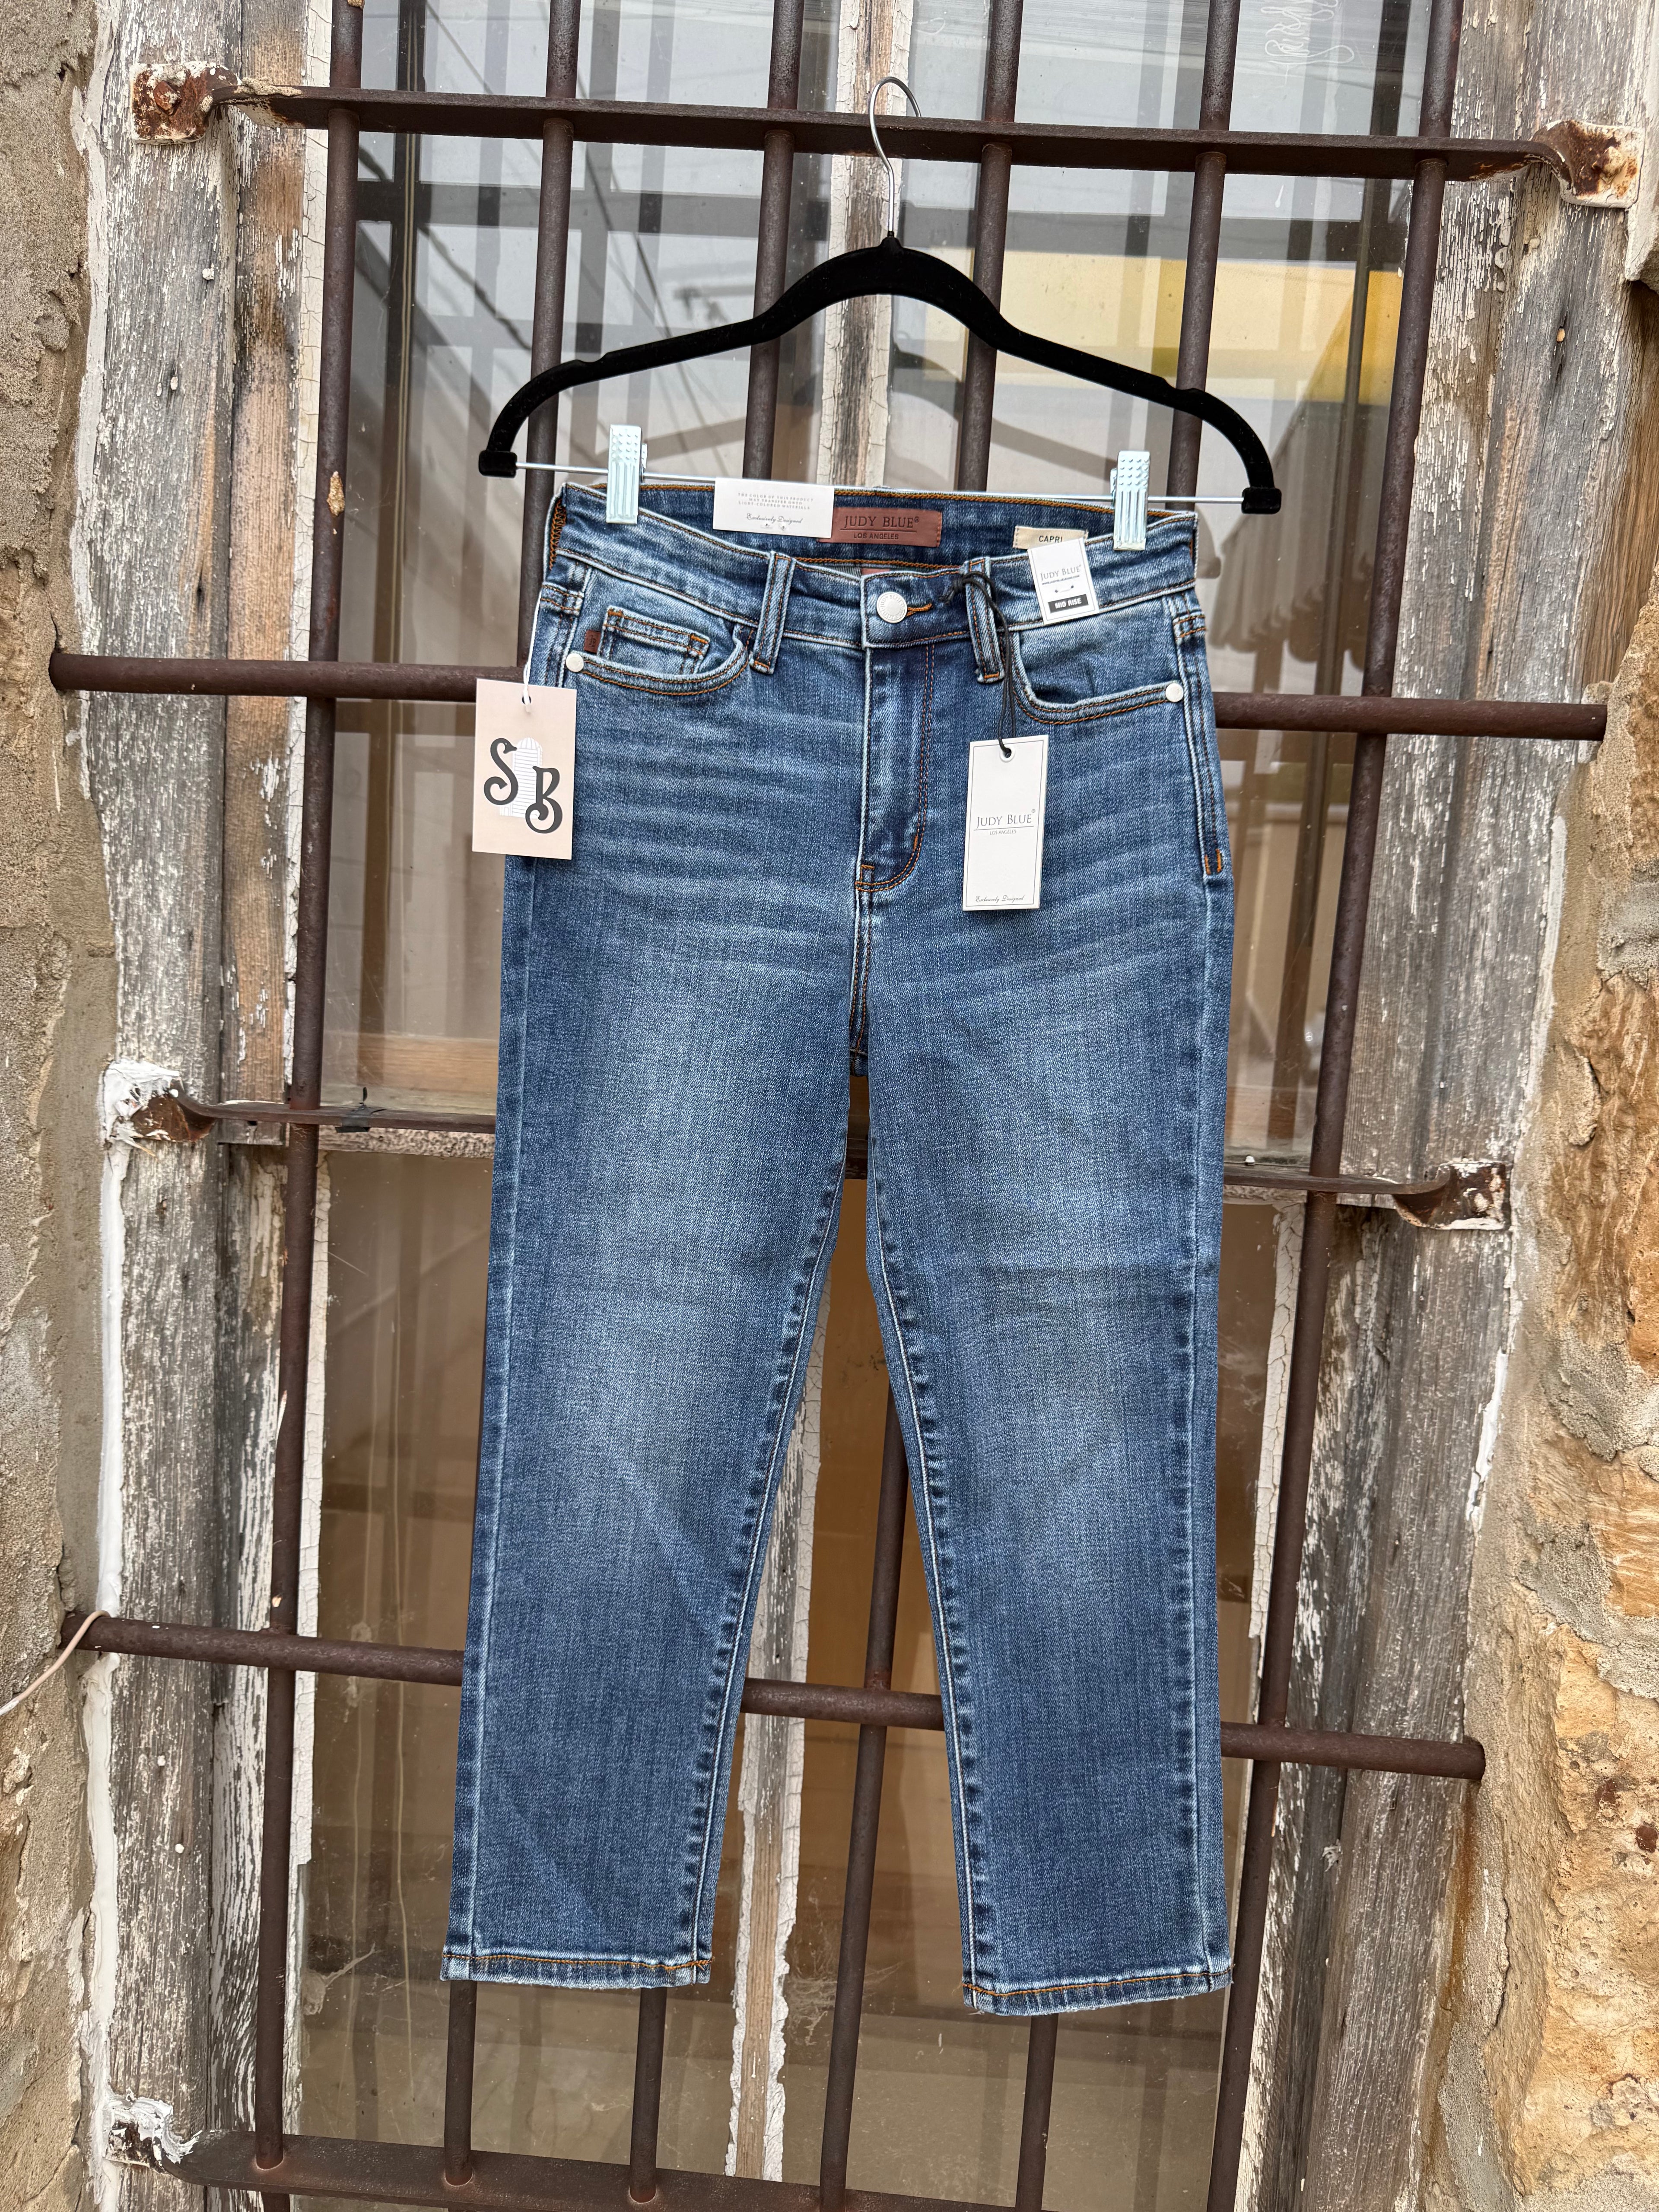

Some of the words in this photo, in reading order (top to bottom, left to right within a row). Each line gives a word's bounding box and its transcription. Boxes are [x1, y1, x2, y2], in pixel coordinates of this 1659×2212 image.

[747, 513, 776, 524] Exclusively
[777, 515, 803, 525] Designed
[844, 515, 877, 528] JUDY
[1040, 570, 1059, 582] JUDY
[1068, 597, 1082, 606] RISE
[976, 816, 1003, 830] JUDY
